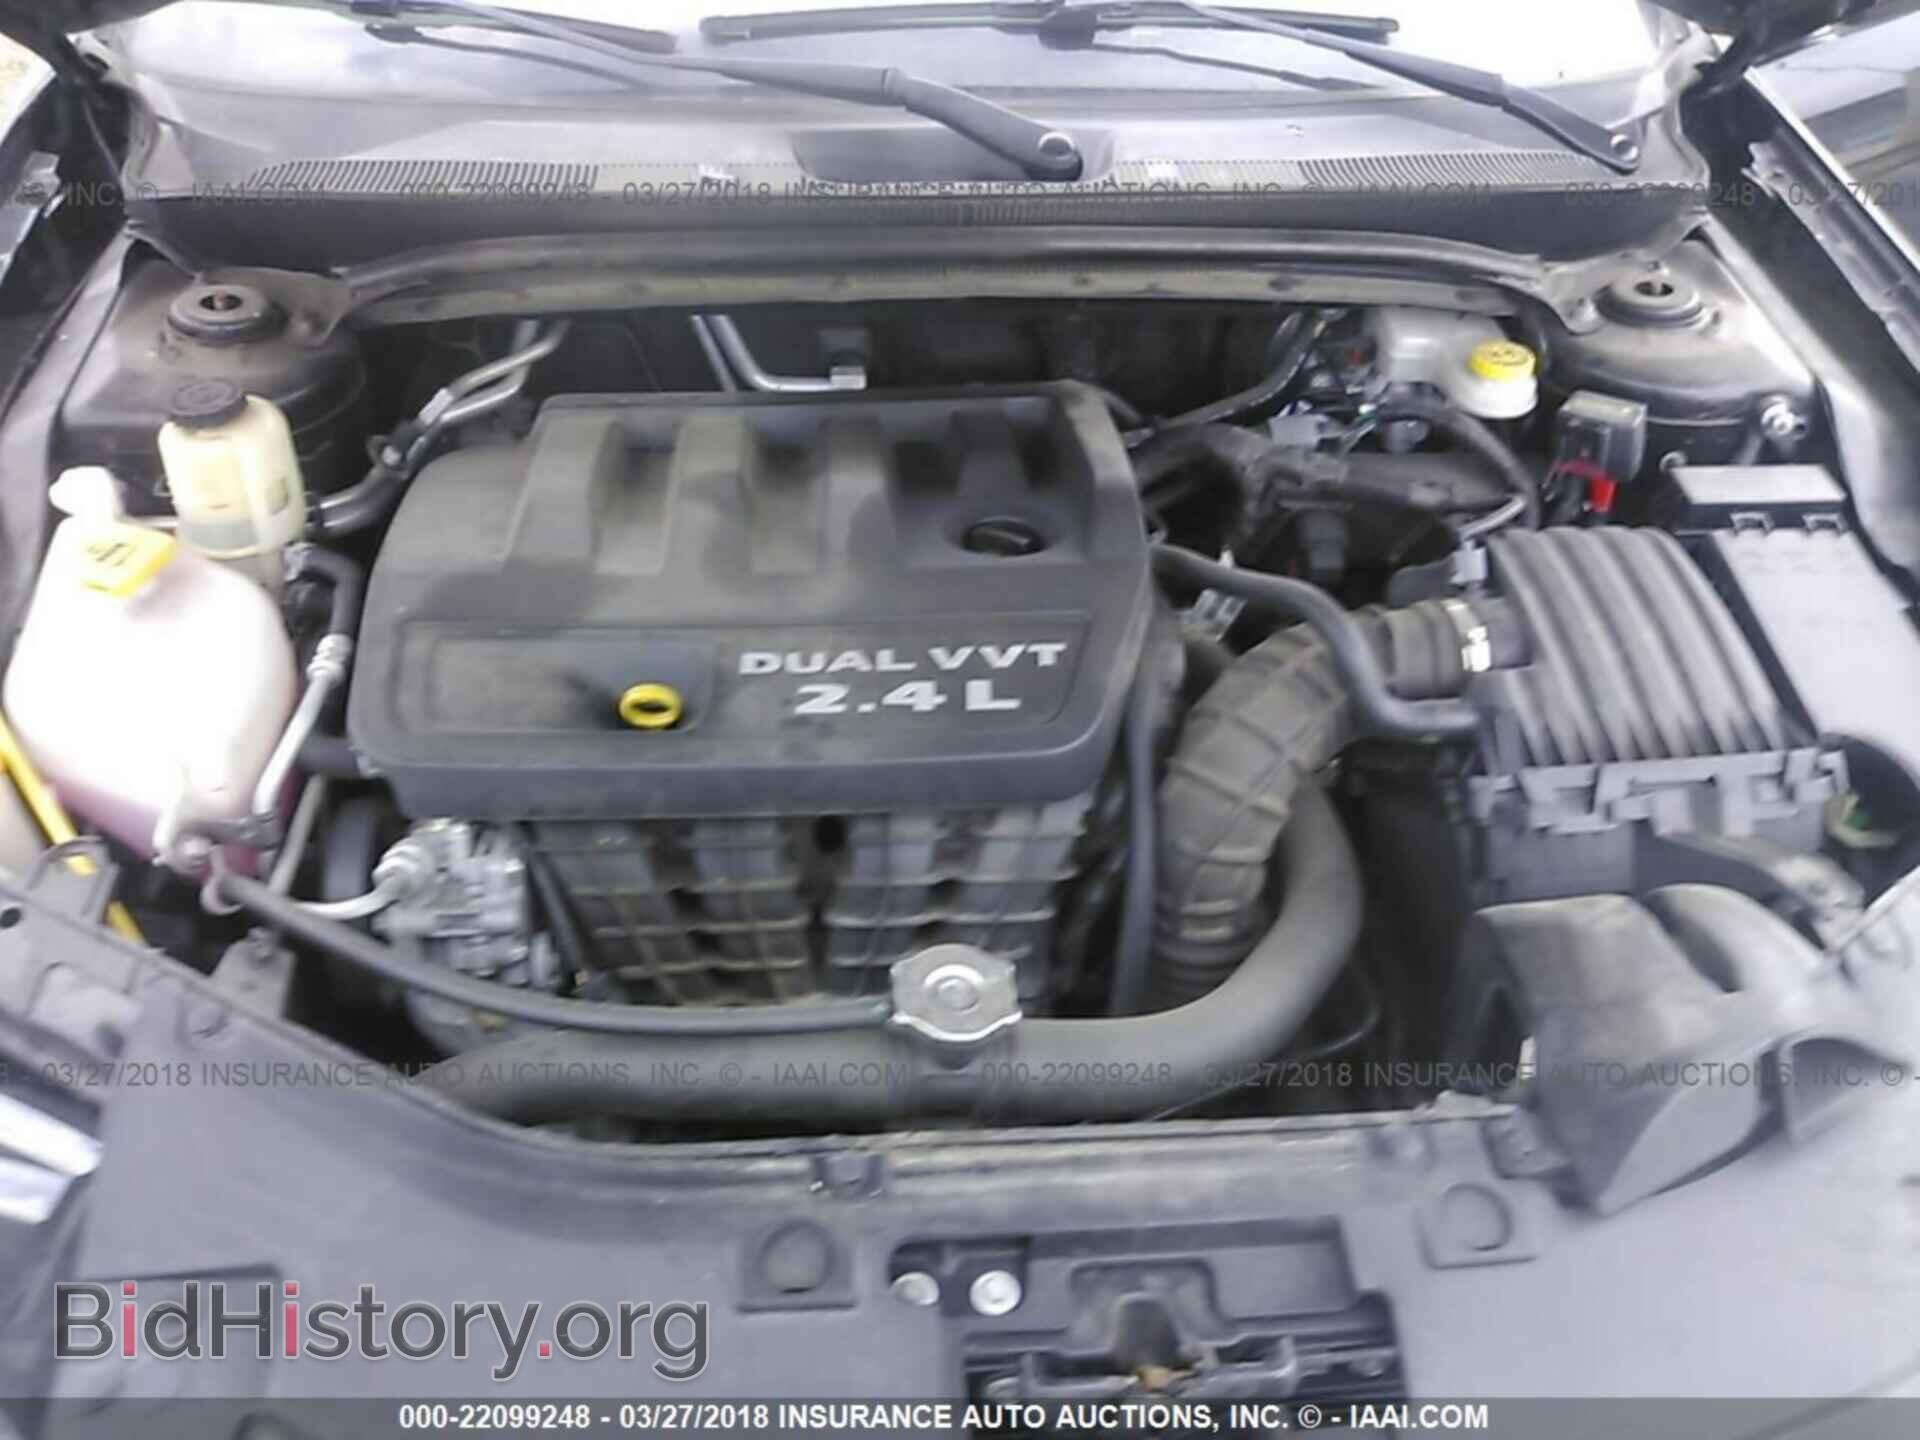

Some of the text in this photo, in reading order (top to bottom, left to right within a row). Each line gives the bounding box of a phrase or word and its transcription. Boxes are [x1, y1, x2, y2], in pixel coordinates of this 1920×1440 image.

[738, 642, 1068, 674] DUAL VVT
[794, 679, 1021, 714] 2.4 L
